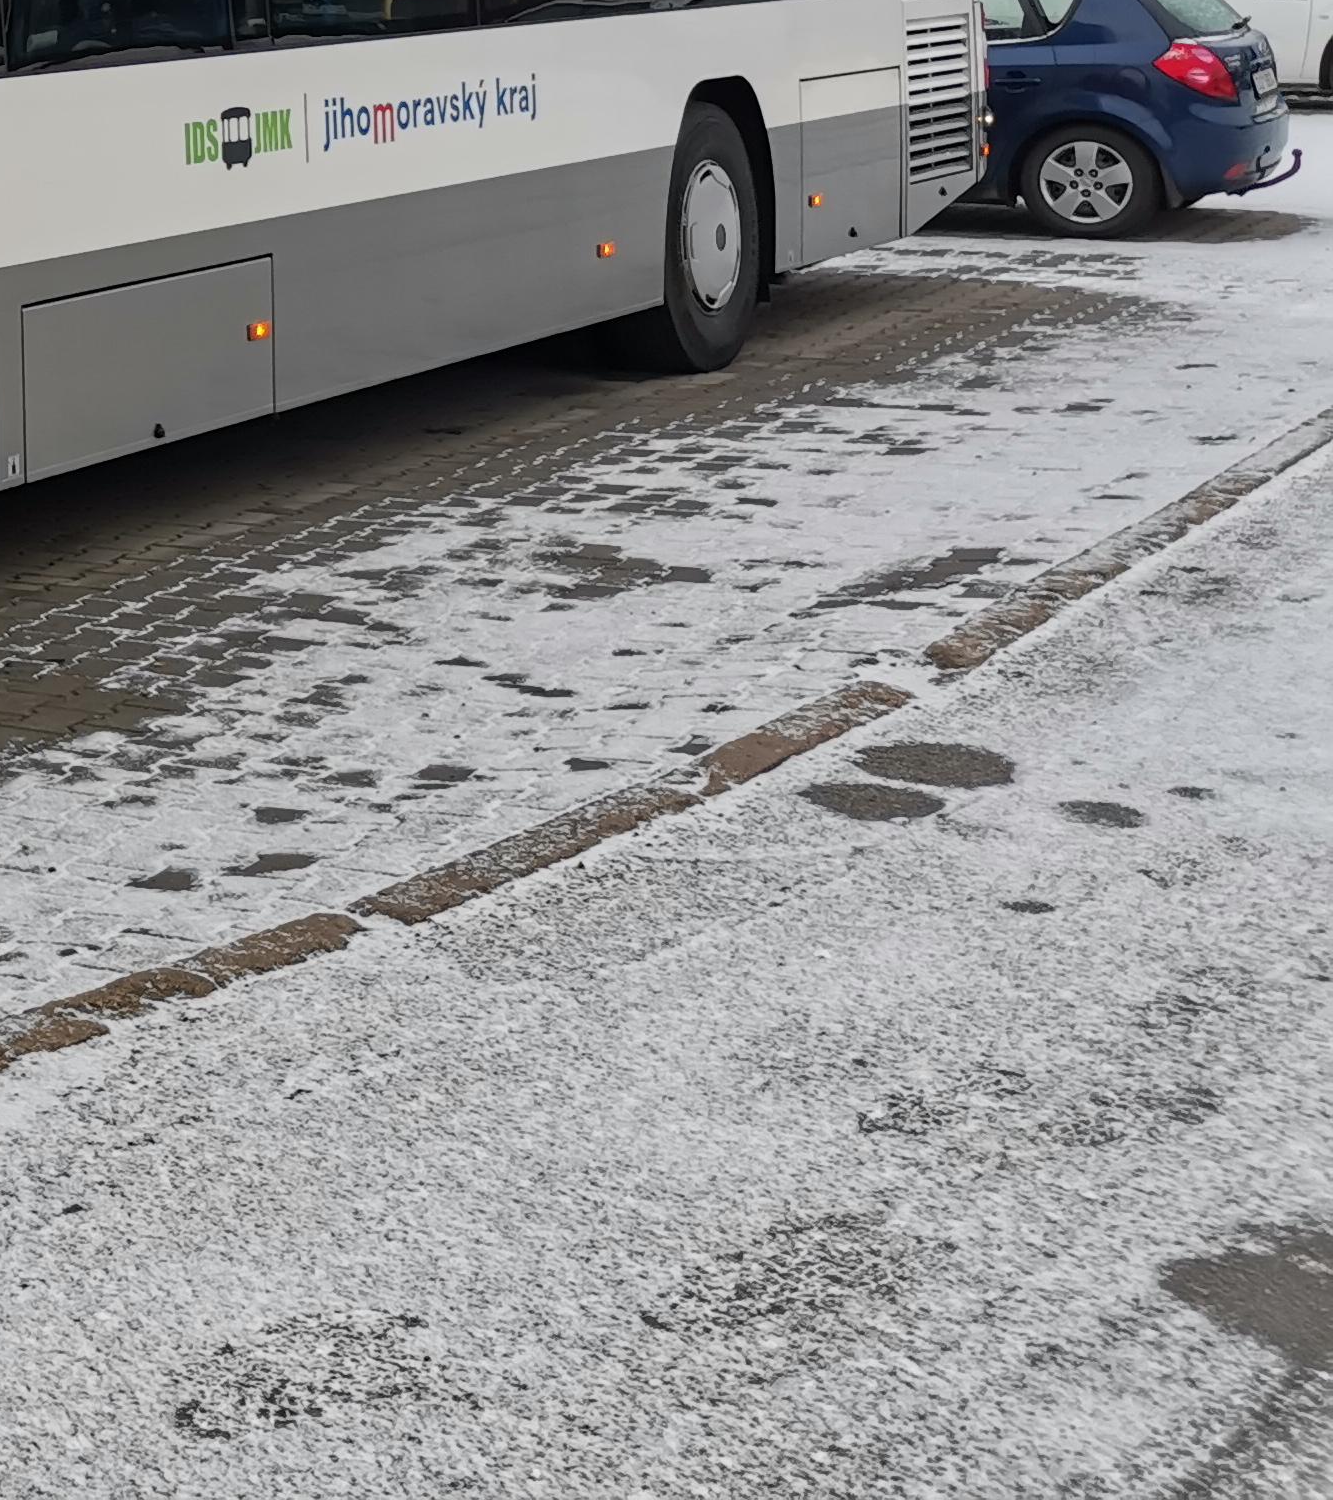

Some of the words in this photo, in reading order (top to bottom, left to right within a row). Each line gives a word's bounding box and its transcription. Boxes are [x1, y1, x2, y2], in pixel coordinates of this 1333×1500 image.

[184, 118, 219, 165] IDS
[254, 108, 293, 154] JMK
[323, 79, 487, 152] jihomoravský
[495, 73, 537, 121] kraj
